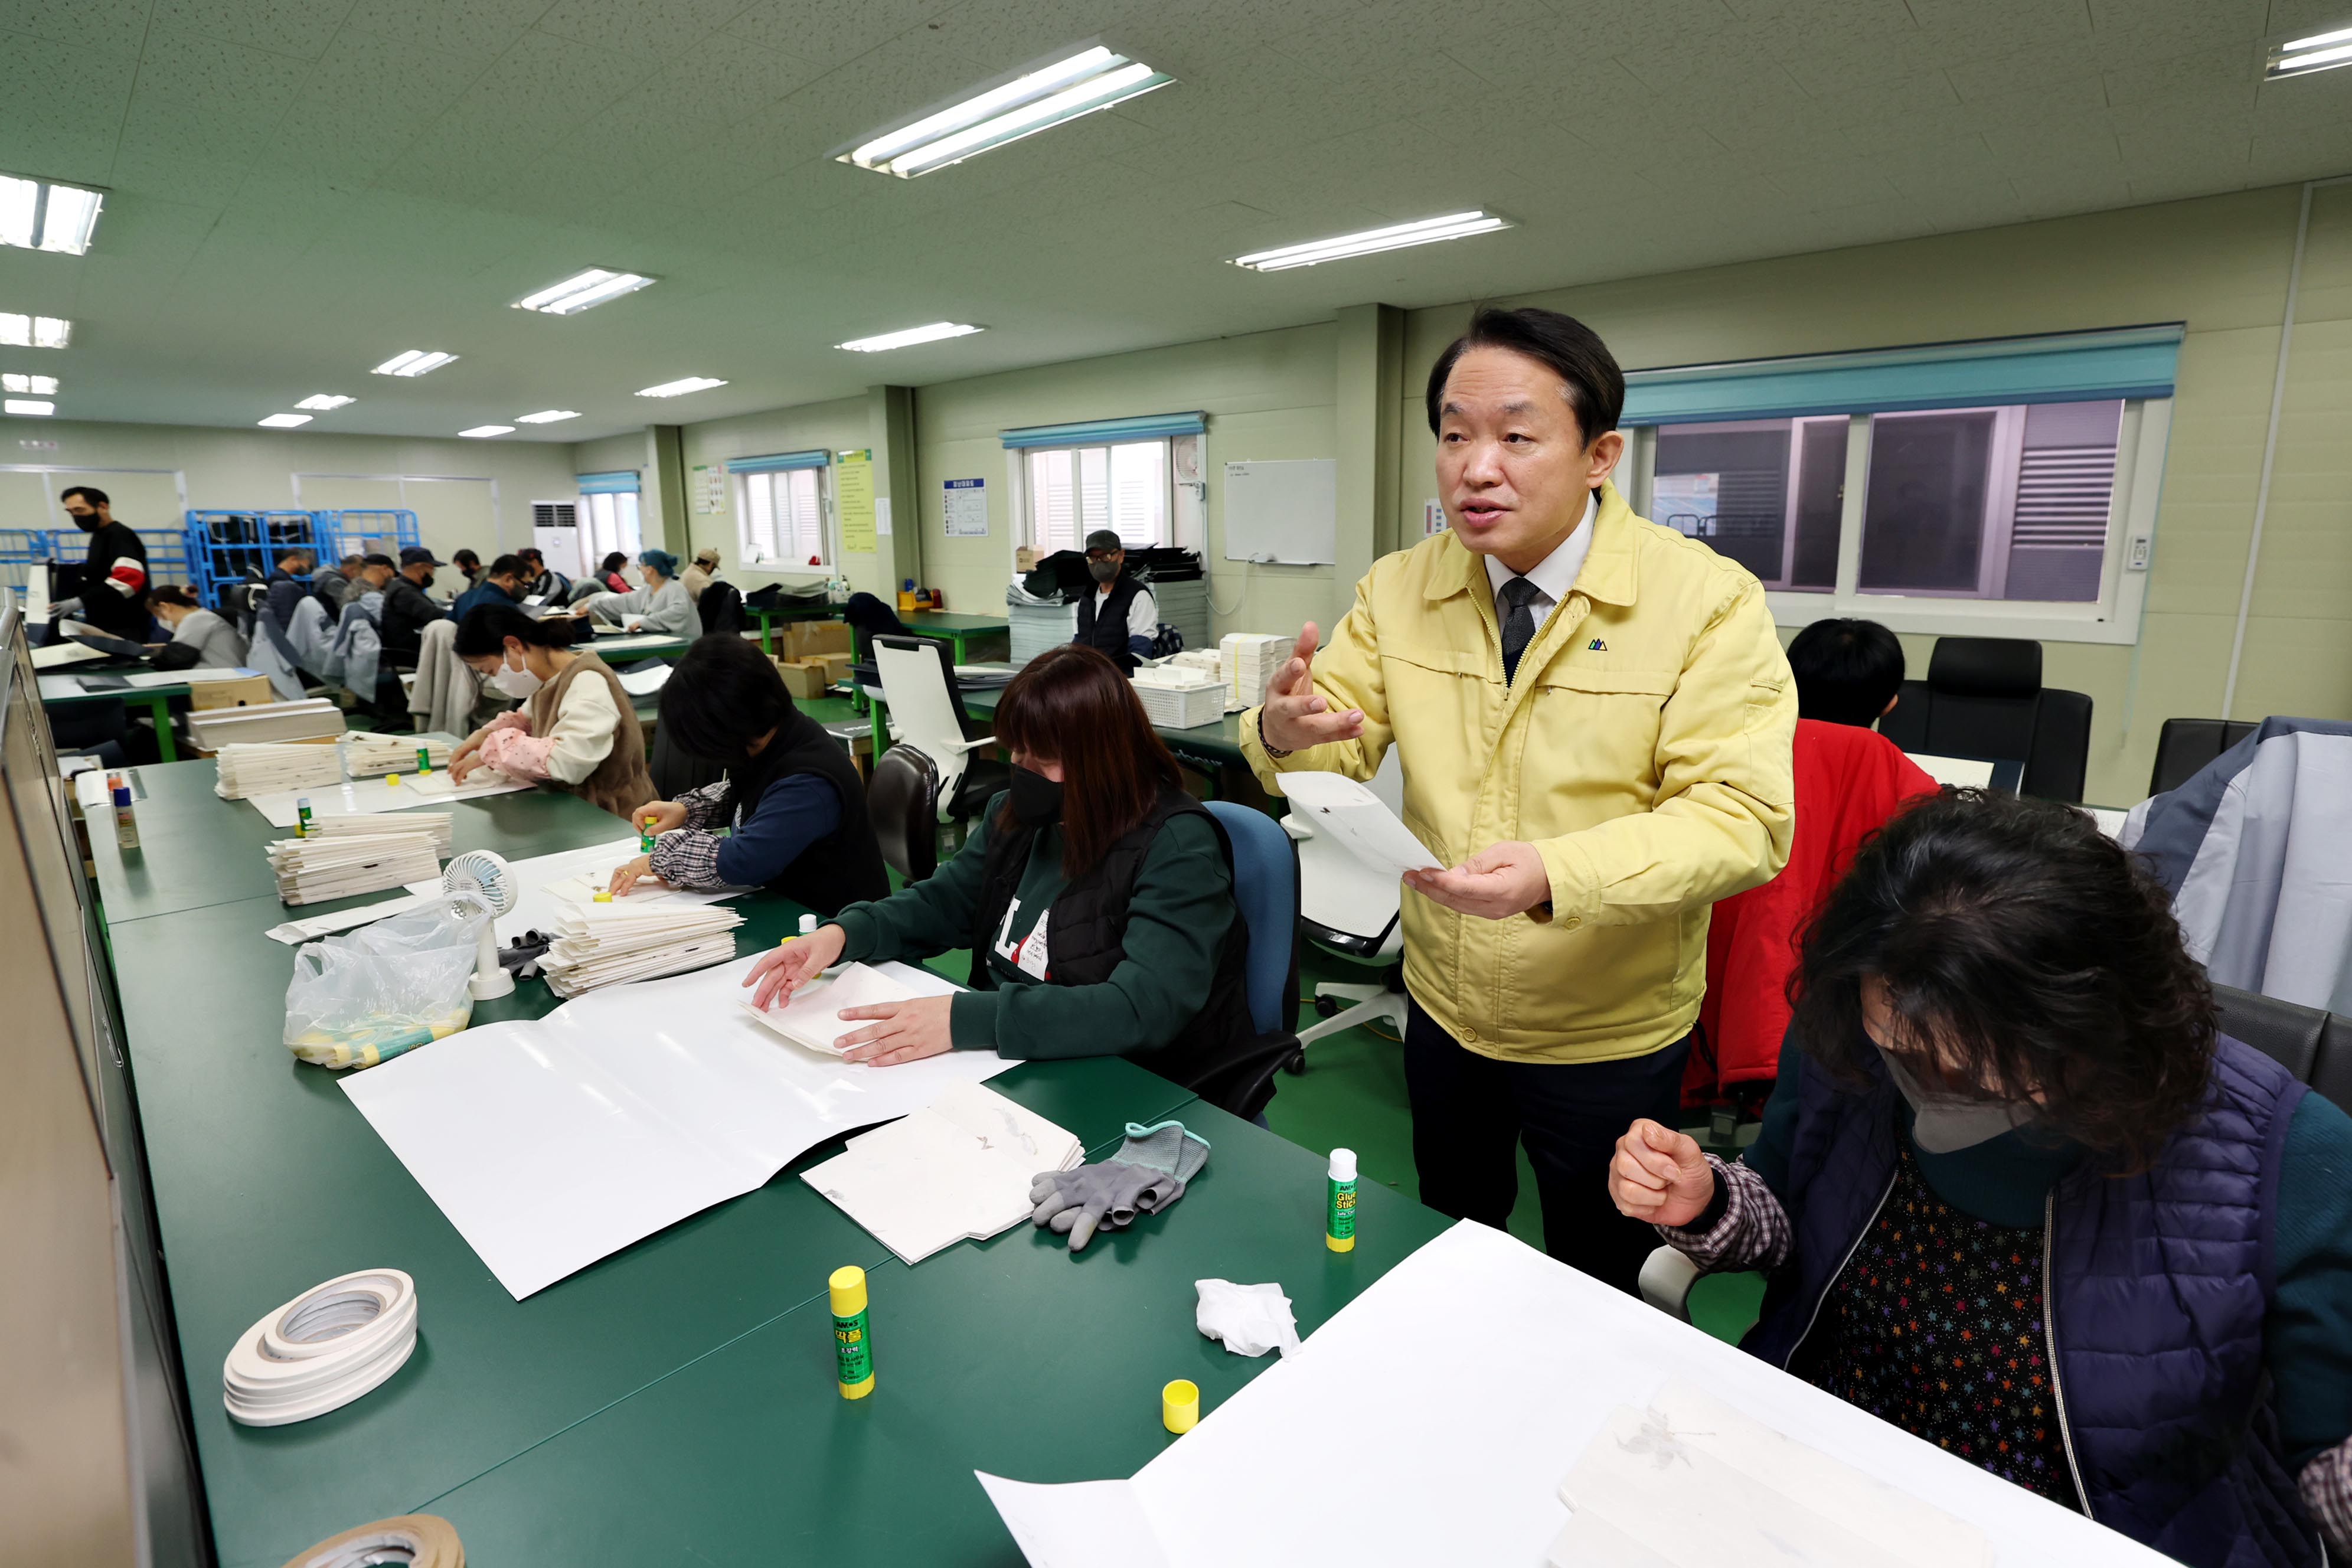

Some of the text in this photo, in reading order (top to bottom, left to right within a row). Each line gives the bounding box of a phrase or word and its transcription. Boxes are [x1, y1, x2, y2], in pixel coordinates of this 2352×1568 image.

[1337, 1191, 1357, 1201] Glue
[837, 1320, 858, 1328] AMOS
[835, 1328, 862, 1344] 딱풀
